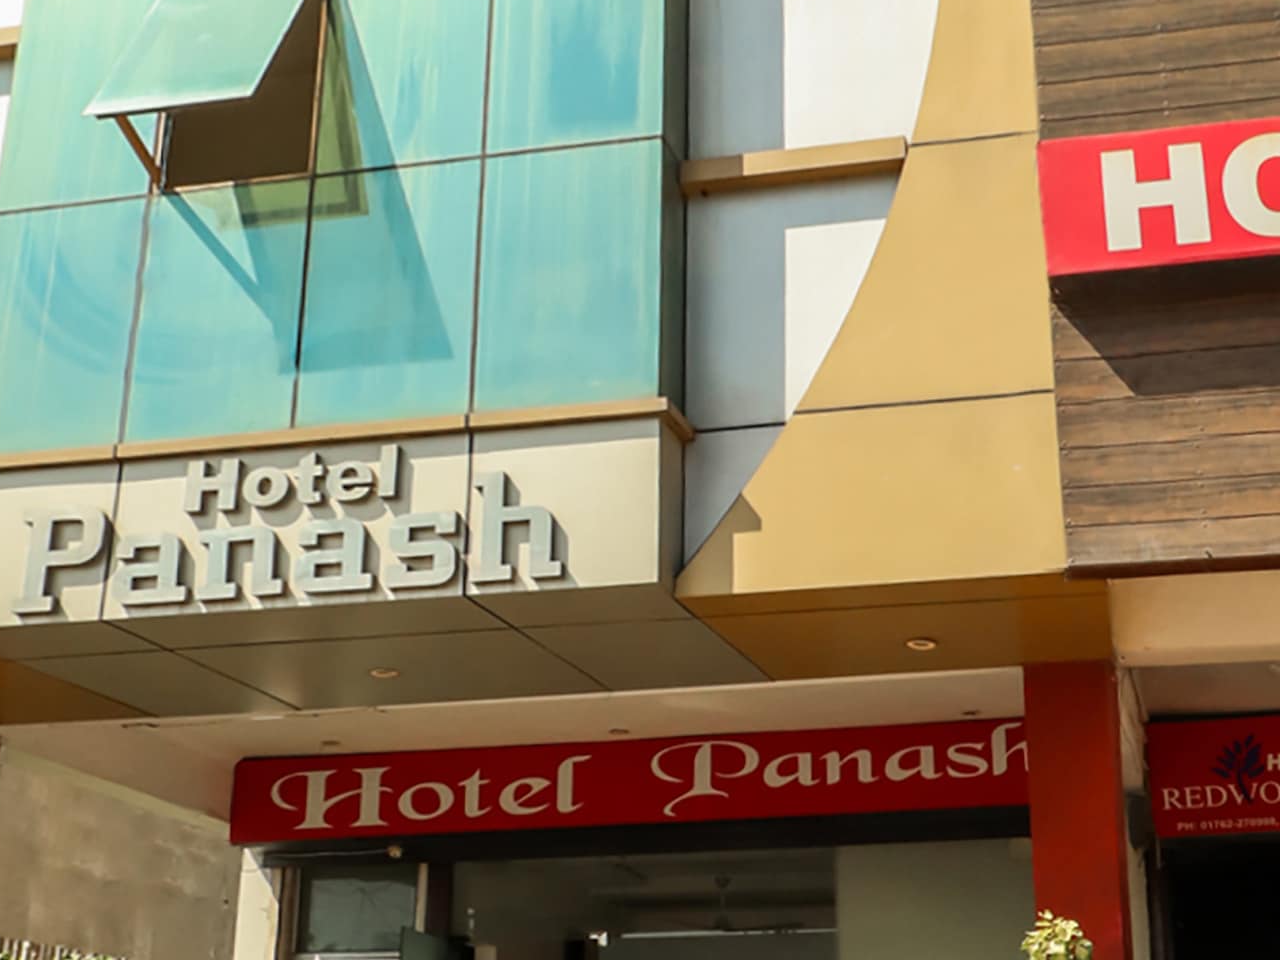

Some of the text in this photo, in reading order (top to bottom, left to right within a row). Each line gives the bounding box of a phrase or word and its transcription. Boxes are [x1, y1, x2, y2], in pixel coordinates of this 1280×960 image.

[184, 444, 400, 513] Hotel
[14, 471, 562, 614] Panash
[270, 722, 1029, 830] Hotel Panash
